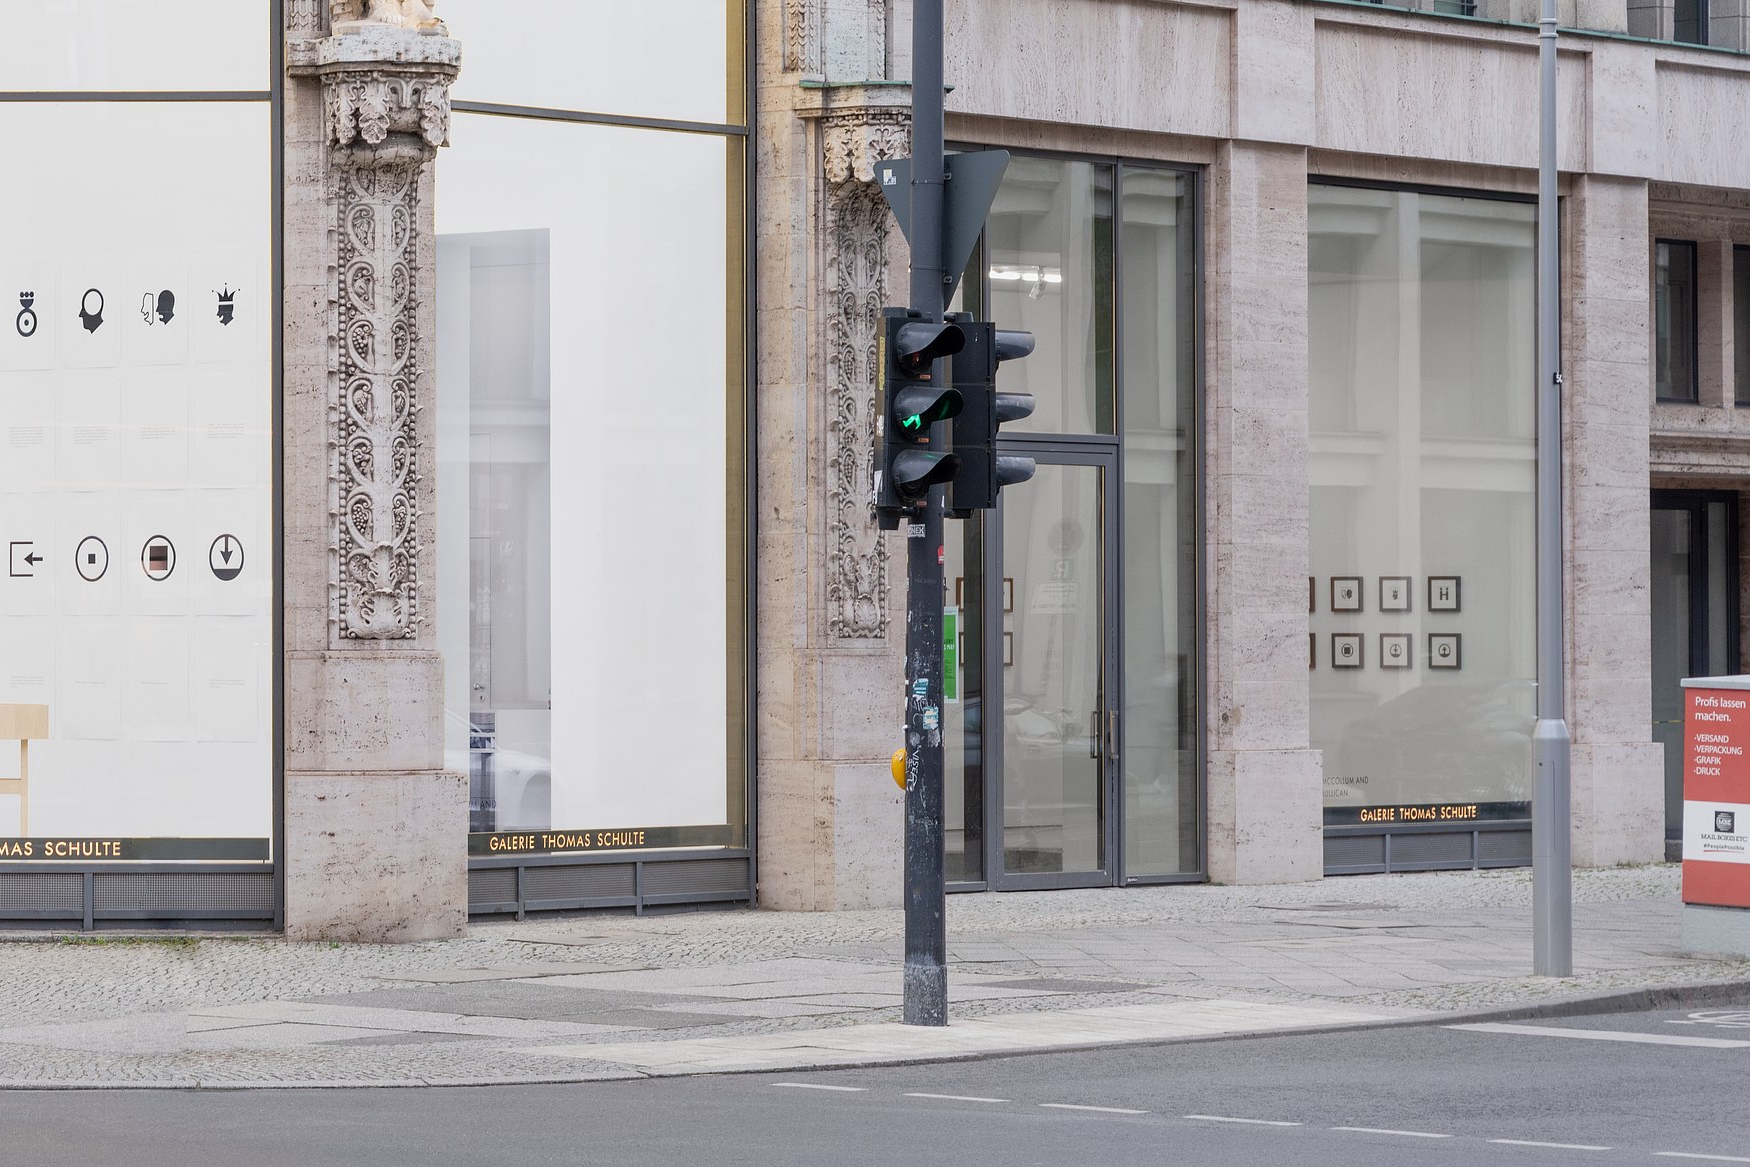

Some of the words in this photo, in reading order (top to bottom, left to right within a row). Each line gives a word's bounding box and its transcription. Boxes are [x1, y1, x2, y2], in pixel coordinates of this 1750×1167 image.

[1695, 696, 1719, 708] Profis
[1720, 697, 1746, 709] lassen
[1695, 711, 1732, 722] machen.
[1355, 776, 1369, 785] AND
[480, 800, 497, 809] AND
[1360, 808, 1395, 822] GALERIE
[1399, 807, 1436, 821] THOMAS
[1440, 805, 1476, 819] SCHULTE
[489, 835, 535, 851] GALERIE
[542, 833, 591, 849] THOMAS
[597, 831, 645, 847] SCHULTE
[44, 841, 121, 856] SCHULTE
